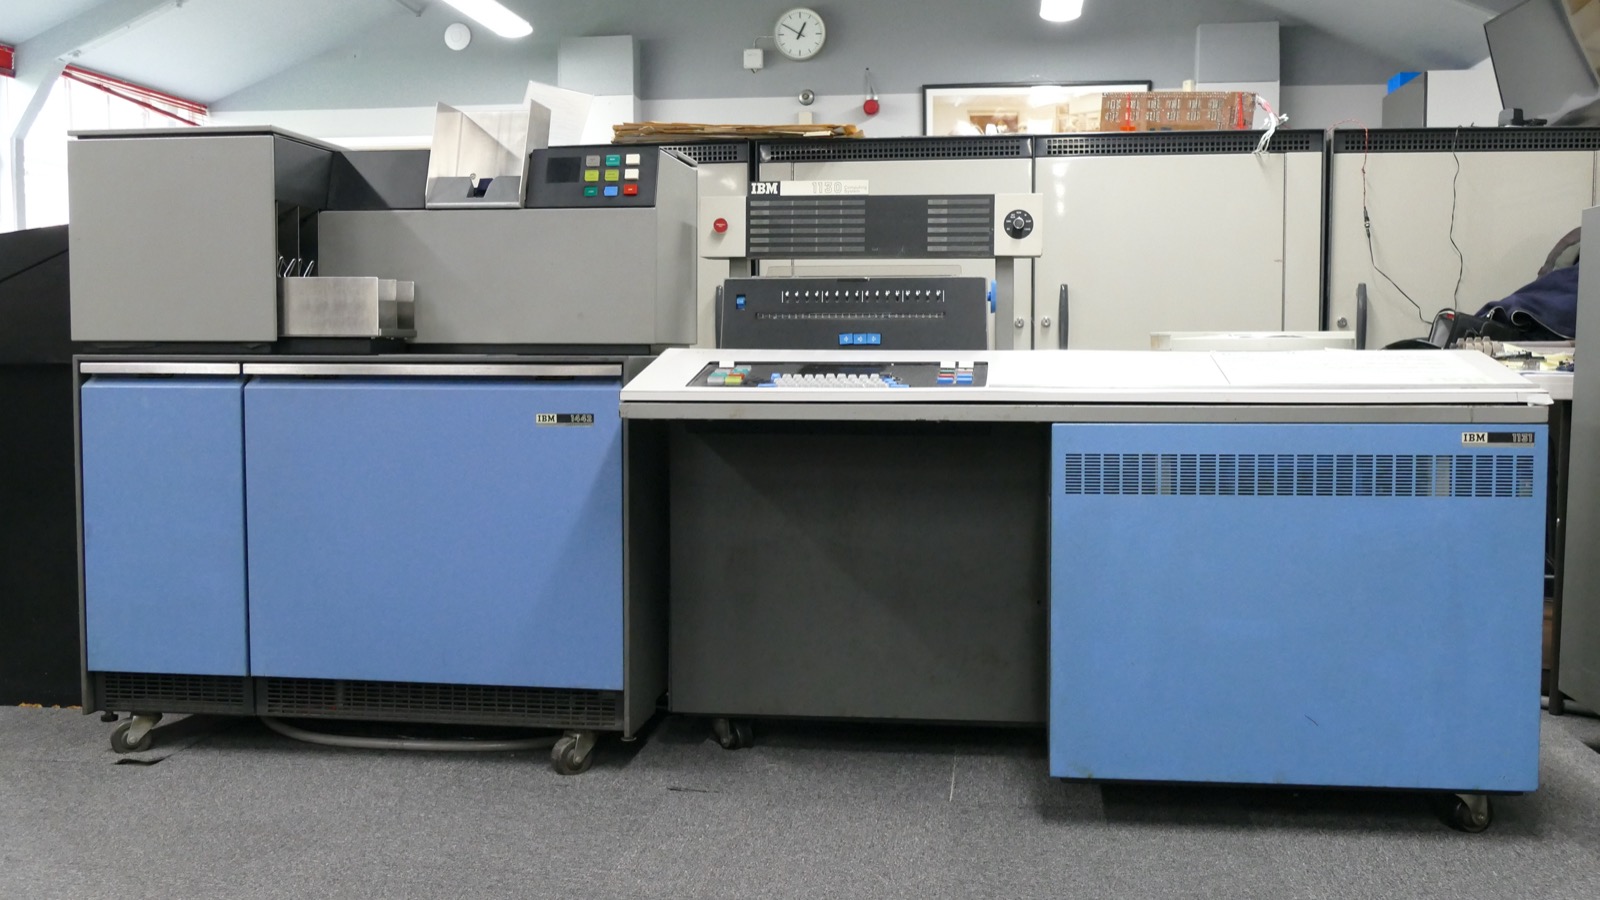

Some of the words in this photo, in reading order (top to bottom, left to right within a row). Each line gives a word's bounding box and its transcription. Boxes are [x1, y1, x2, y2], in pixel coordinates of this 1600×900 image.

[751, 182, 778, 195] IBM
[812, 182, 842, 194] 1130
[537, 414, 555, 422] IBM
[1463, 433, 1485, 442] IBM
